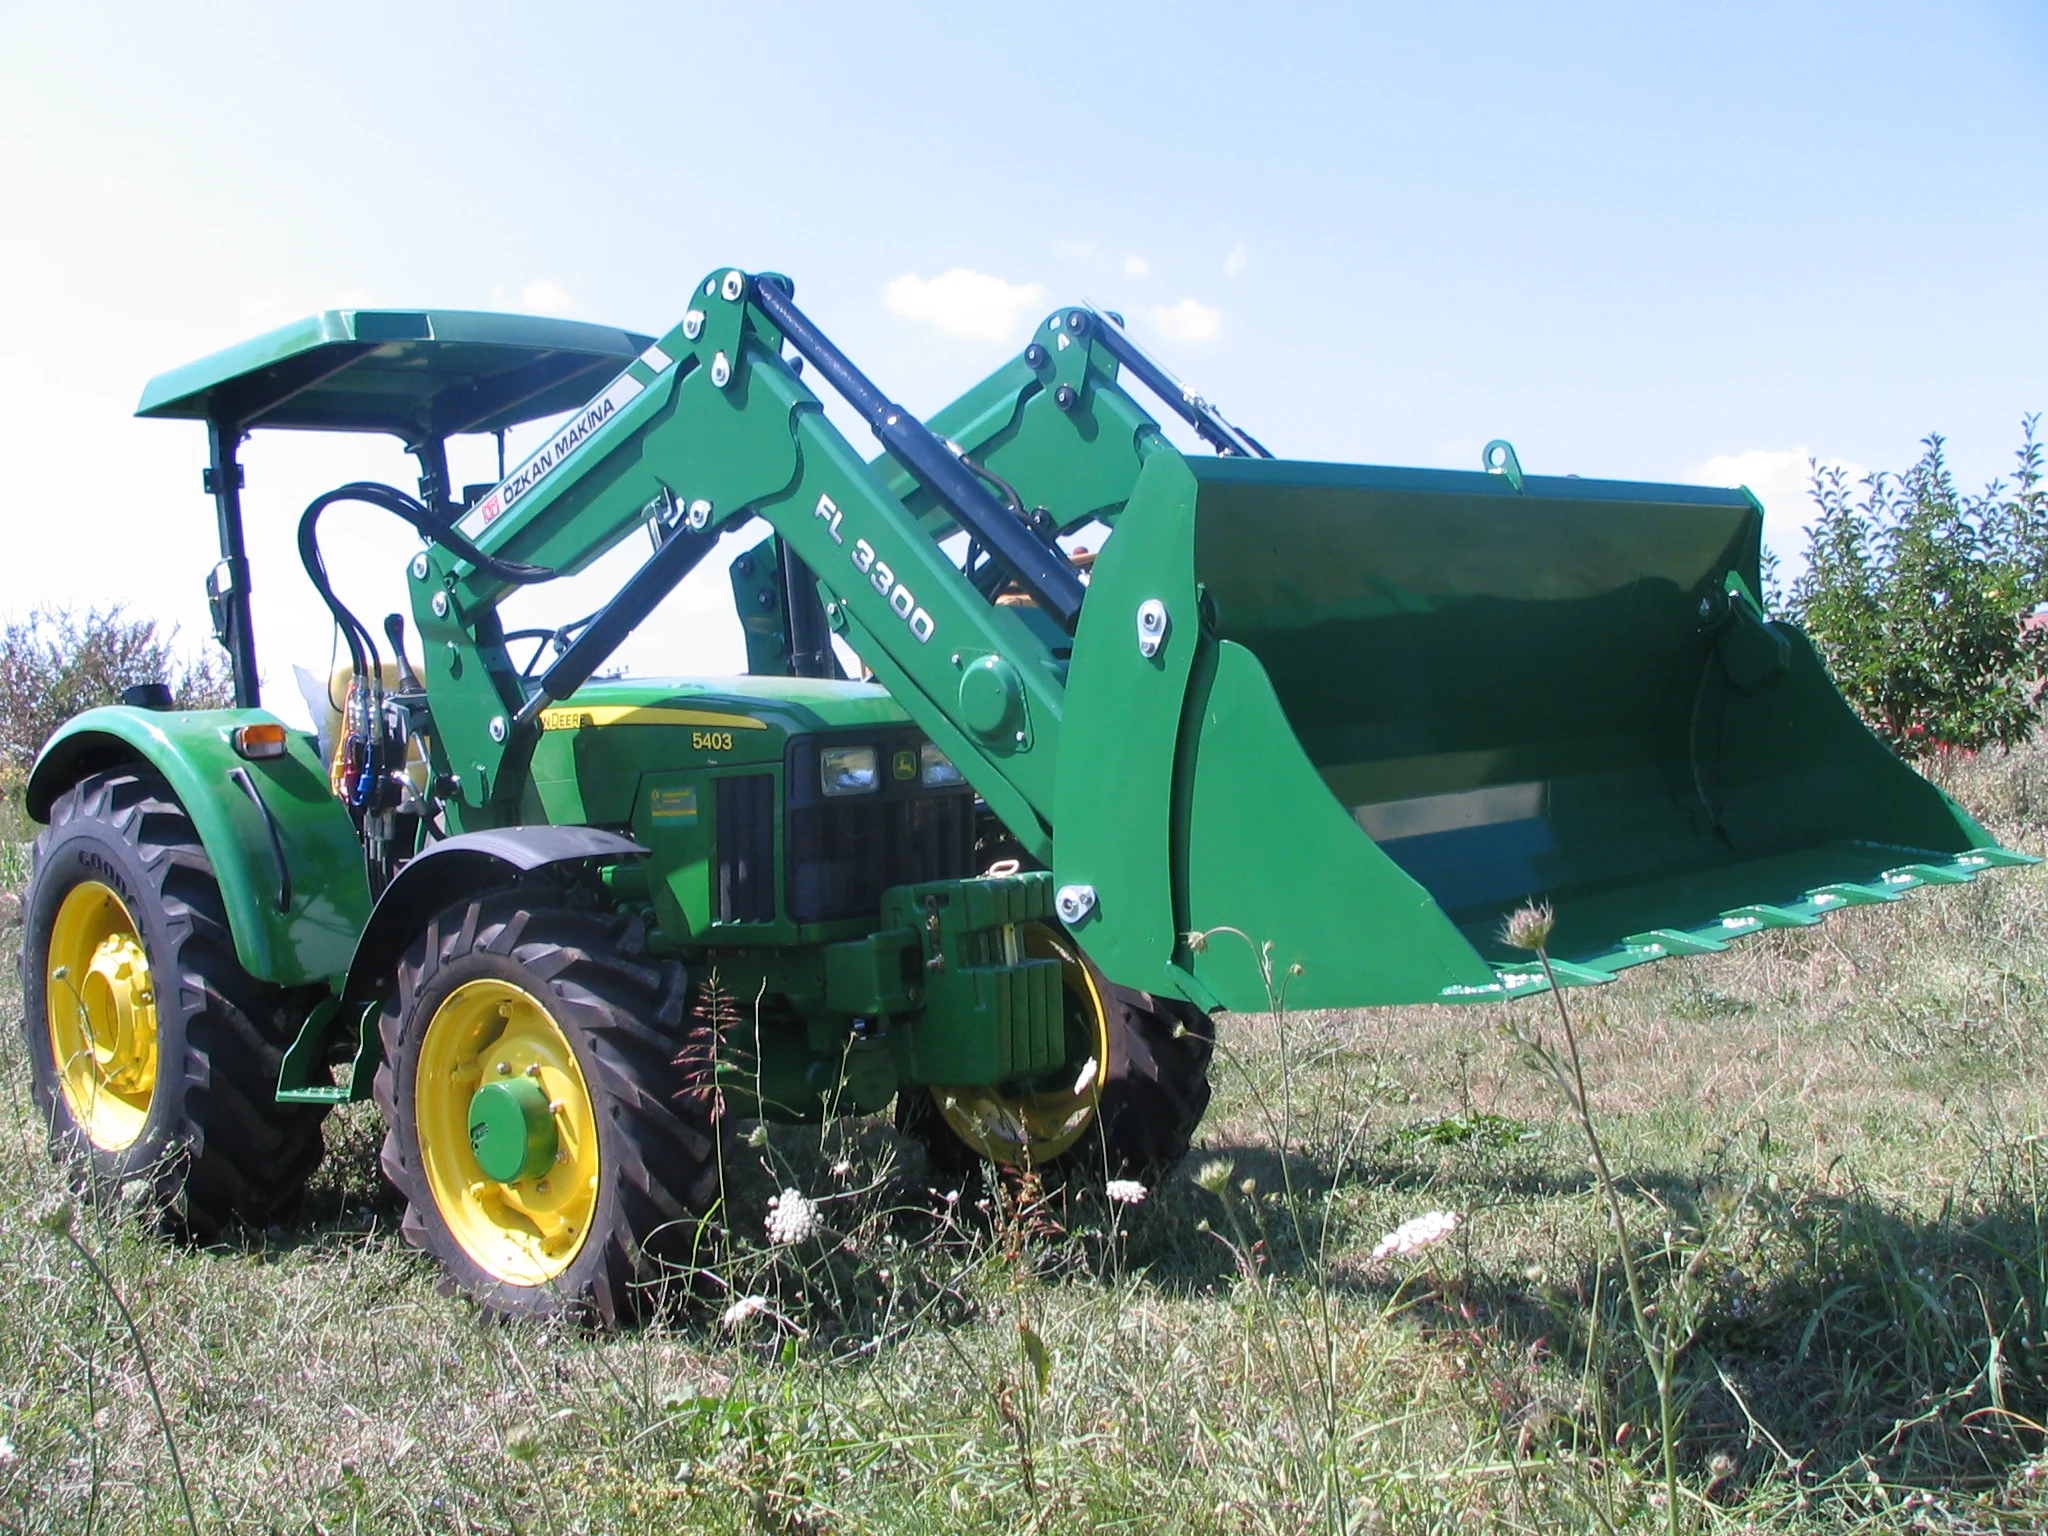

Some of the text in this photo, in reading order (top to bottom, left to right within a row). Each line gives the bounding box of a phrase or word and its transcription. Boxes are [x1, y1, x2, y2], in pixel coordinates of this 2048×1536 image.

[503, 398, 615, 505] ÖZKAN MAKİNA
[814, 493, 936, 645] FL 3300
[692, 732, 733, 751] 5403
